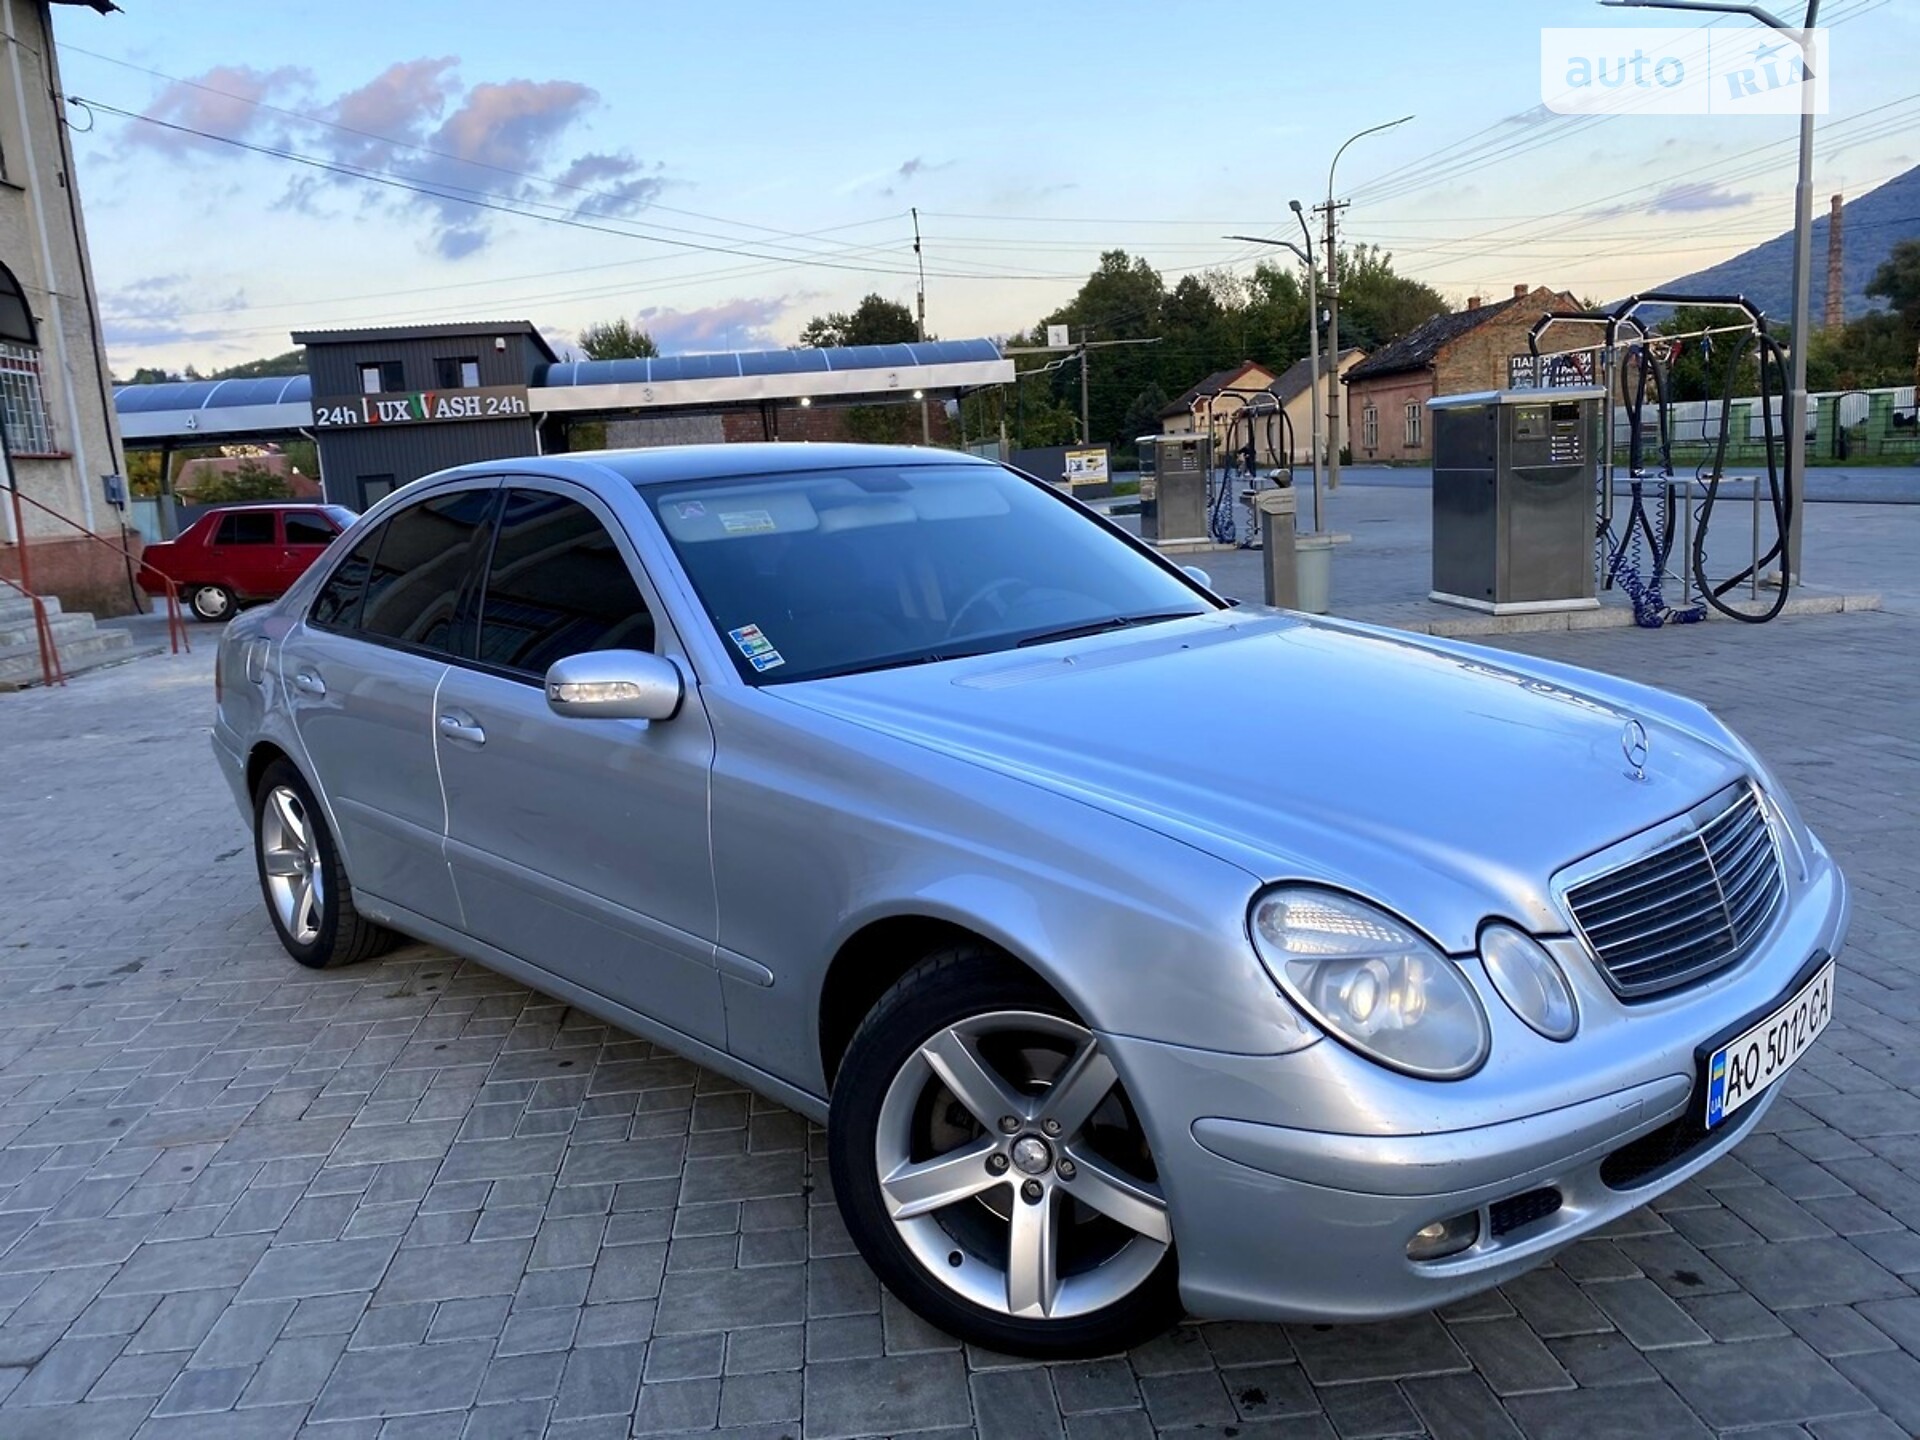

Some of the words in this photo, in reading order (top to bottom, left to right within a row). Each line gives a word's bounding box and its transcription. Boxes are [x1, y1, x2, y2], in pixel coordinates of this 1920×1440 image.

[185, 413, 198, 430] 4
[316, 406, 358, 426] 24h
[486, 397, 526, 416] 24h
[1725, 1042, 1760, 1107] AO
[1765, 1003, 1807, 1076] 5012
[1710, 1096, 1722, 1114] UA
